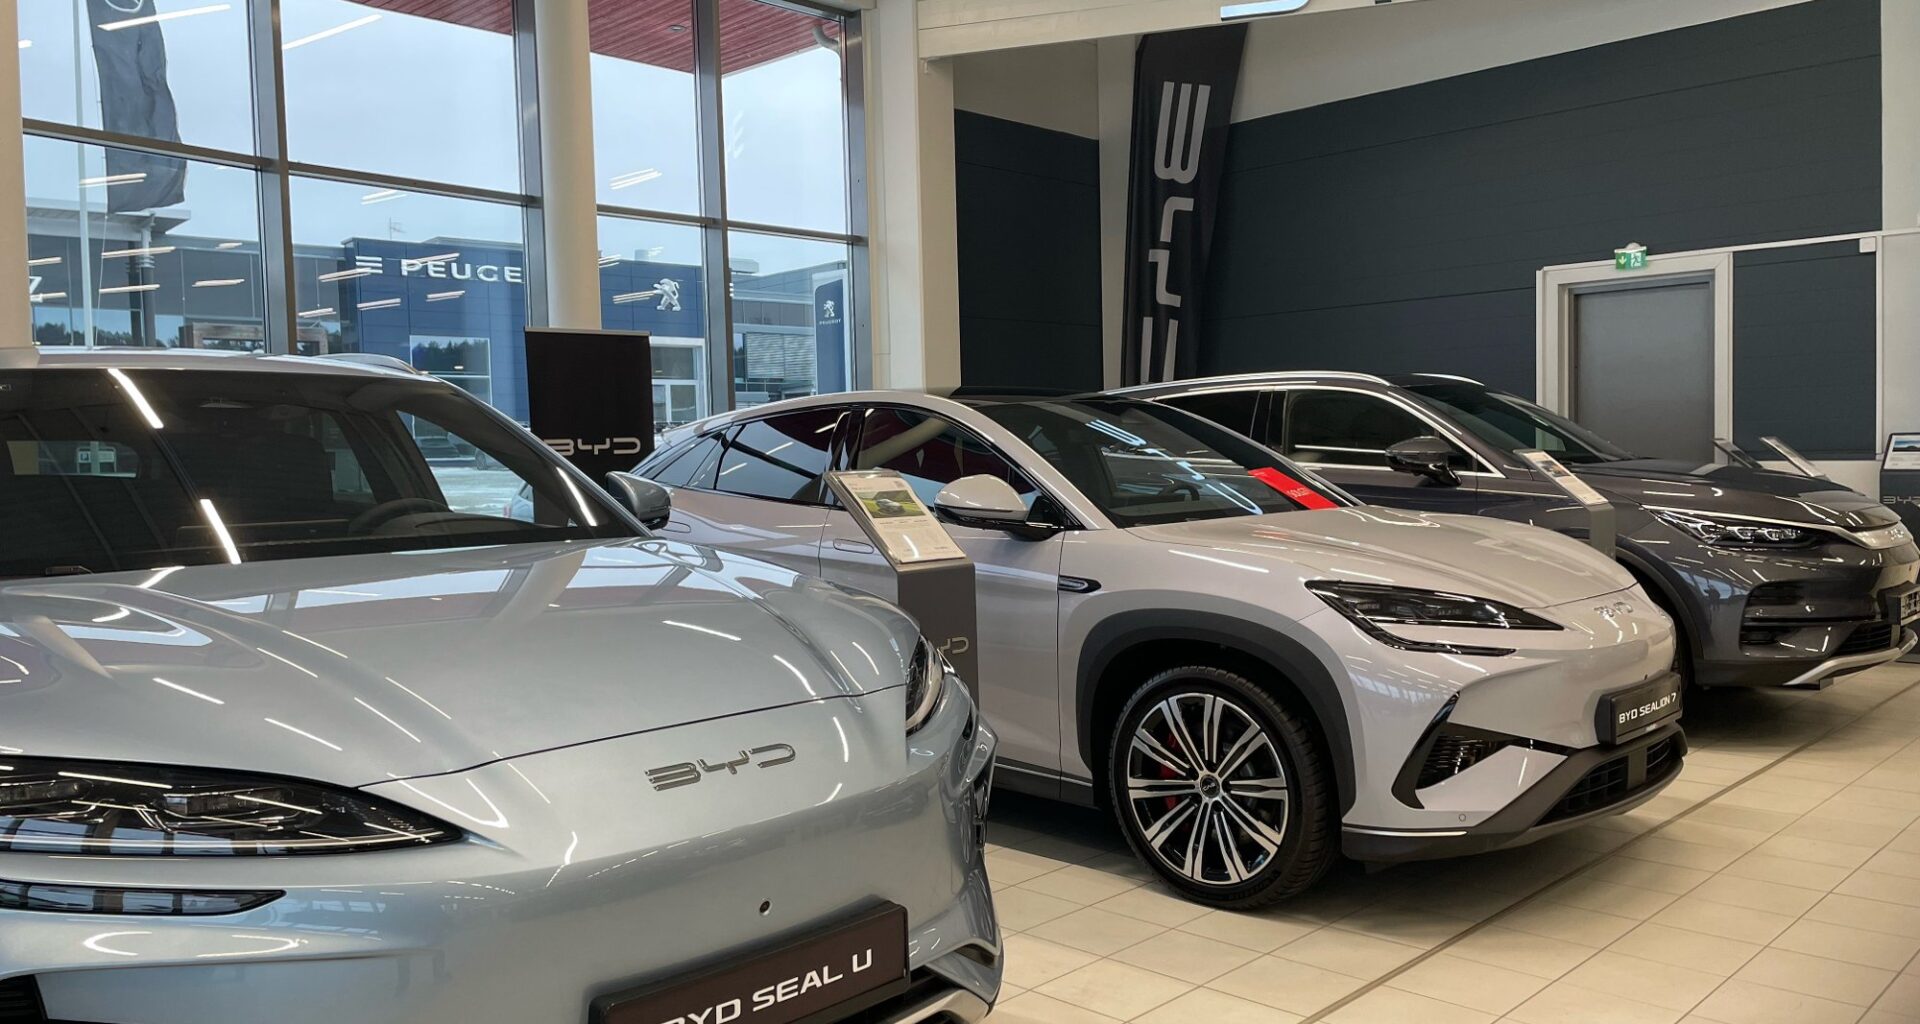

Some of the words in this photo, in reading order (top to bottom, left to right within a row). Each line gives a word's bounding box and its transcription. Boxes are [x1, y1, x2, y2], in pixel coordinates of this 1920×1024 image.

[1619, 708, 1638, 724] BYD
[1639, 695, 1671, 717] SEALION
[1671, 692, 1677, 702] 7
[645, 743, 796, 791] BYD
[752, 965, 843, 1011] SEAL
[852, 948, 873, 973] U
